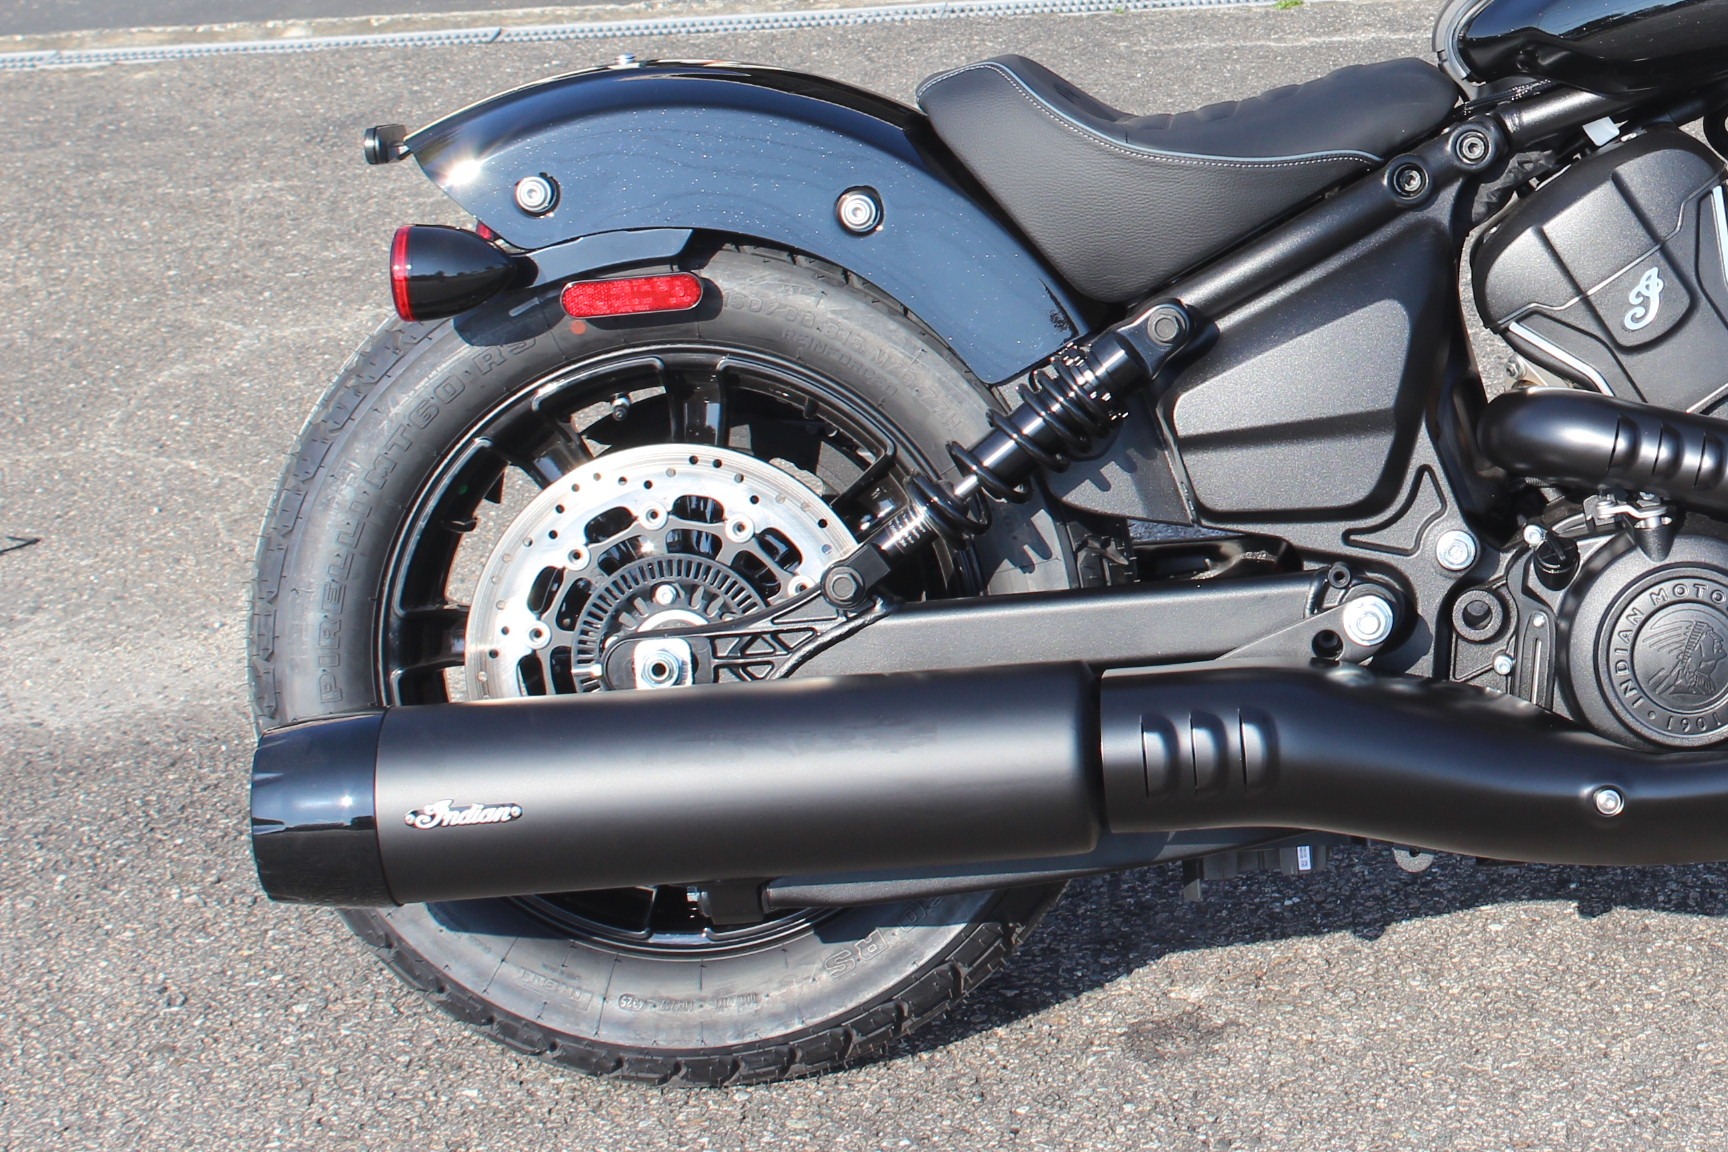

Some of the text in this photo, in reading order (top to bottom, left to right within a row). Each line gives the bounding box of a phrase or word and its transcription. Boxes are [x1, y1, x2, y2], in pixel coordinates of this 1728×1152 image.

[317, 497, 373, 704] PIRELLI
[363, 374, 467, 491] MT60
[1614, 607, 1645, 709] INDIAN
[1666, 711, 1723, 733] 1901
[415, 799, 512, 829] Indian
